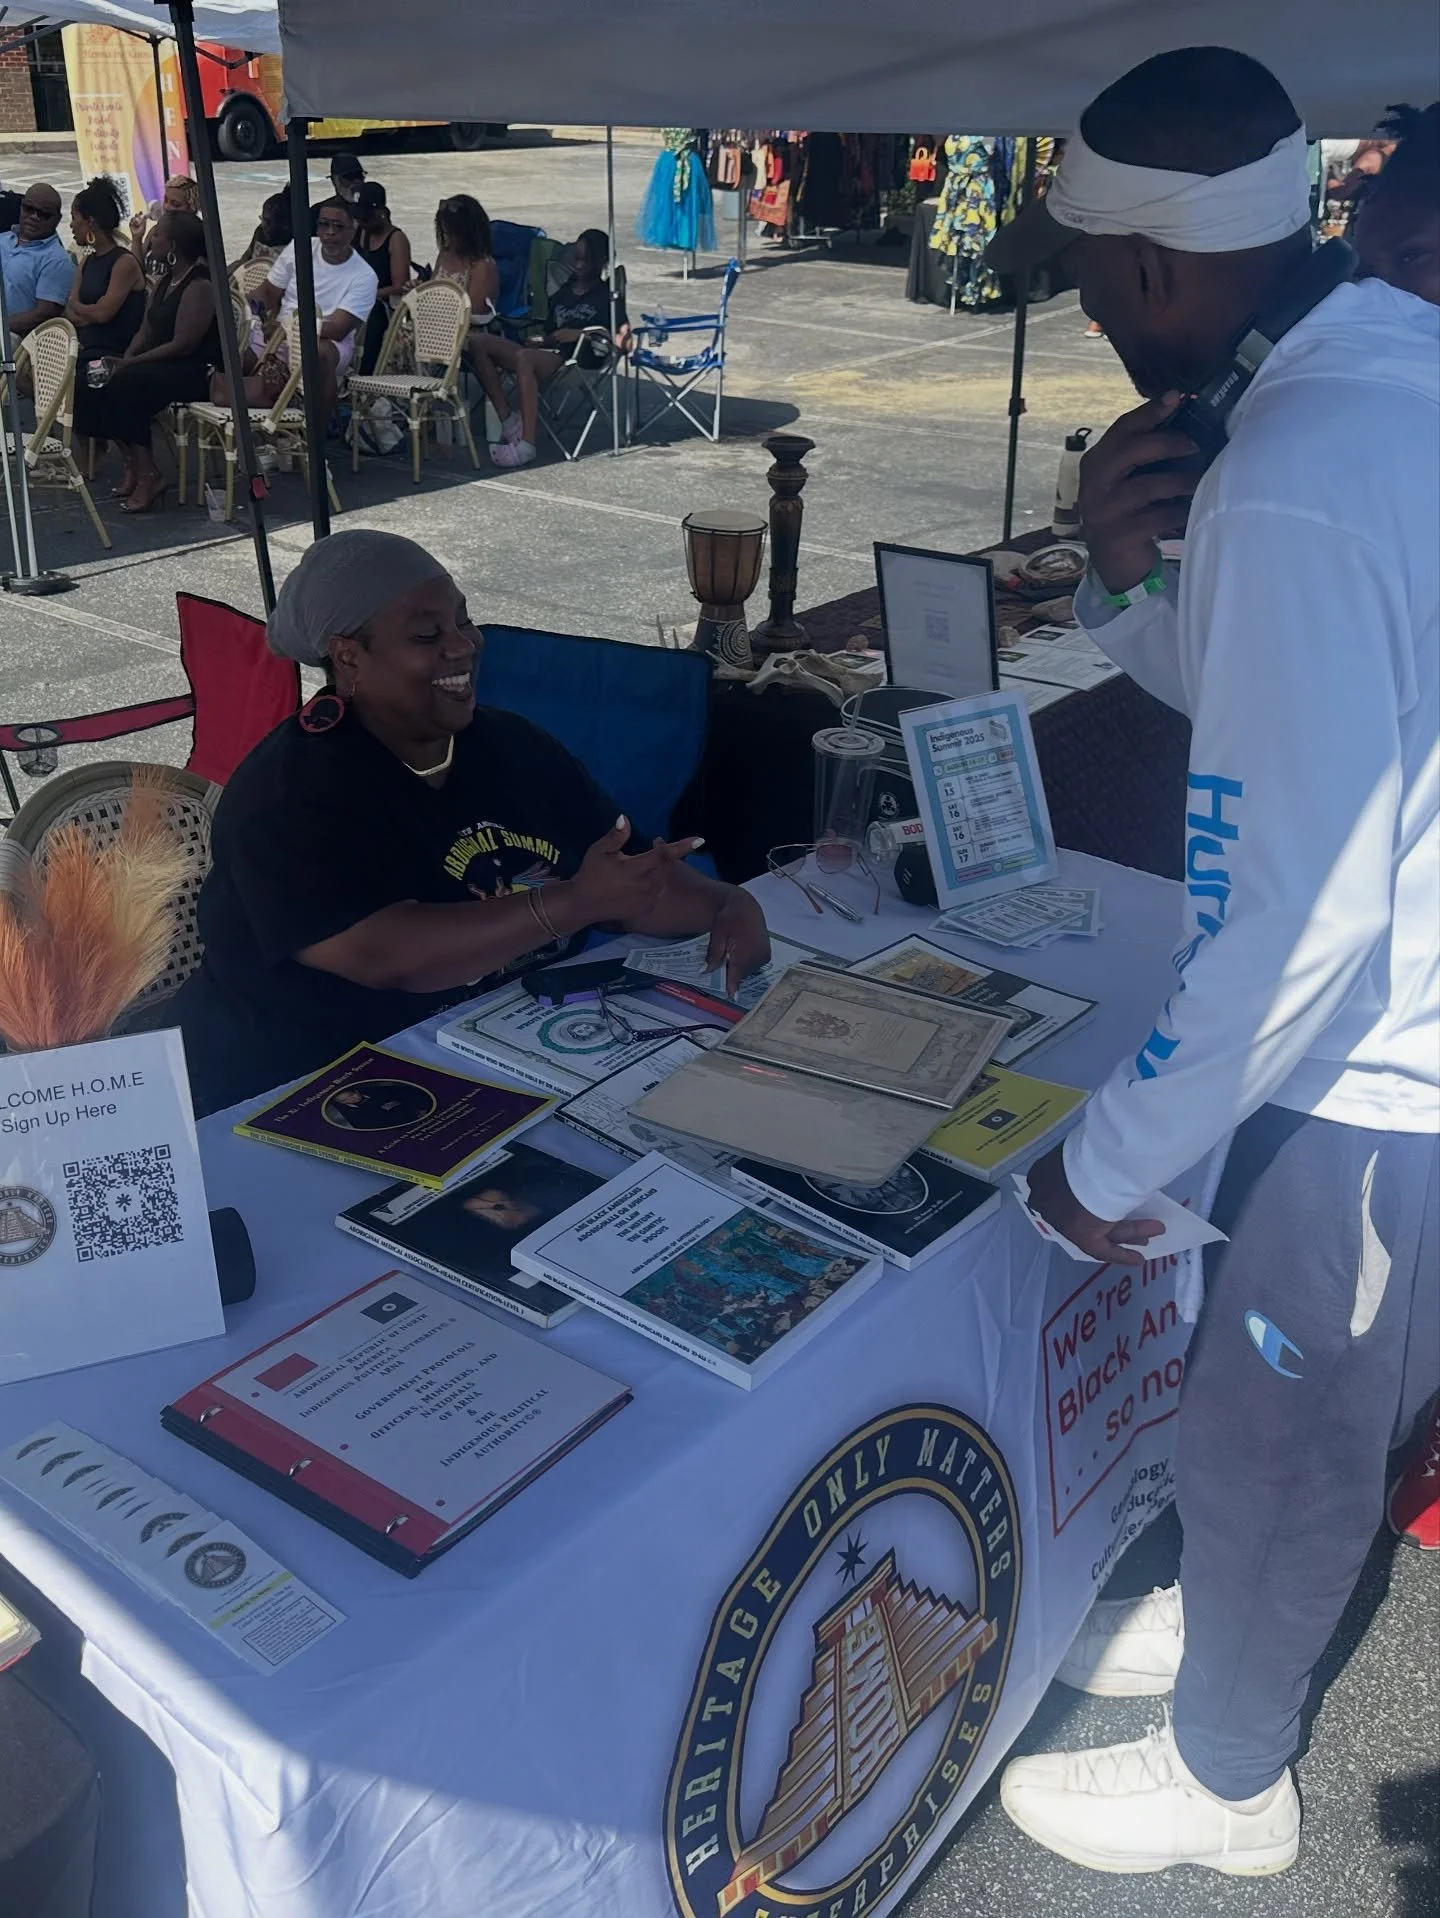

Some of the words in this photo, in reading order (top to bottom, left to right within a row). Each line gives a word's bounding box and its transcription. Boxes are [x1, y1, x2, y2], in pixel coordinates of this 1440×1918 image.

[930, 727, 974, 742] Indigenous
[932, 739, 962, 753] Summit
[964, 733, 985, 746] 2025
[944, 787, 955, 797] 15
[949, 809, 960, 819] 16
[500, 829, 561, 865] SUMMIT
[953, 831, 965, 841] 16
[959, 854, 969, 864] 17
[71, 1072, 144, 1096] H.O.M.E
[2, 1117, 40, 1133] Sign
[46, 1110, 70, 1126] Up
[76, 1103, 117, 1120] Here
[586, 1210, 609, 1225] BLACK
[616, 1228, 631, 1237] THE
[629, 1211, 656, 1229] HISTORY
[628, 1211, 640, 1220] LAW
[640, 1217, 666, 1234] GENETIC
[642, 1226, 669, 1243] PROOFS
[1053, 1273, 1133, 1370] We're
[293, 1361, 347, 1399] ABORIGINAL
[347, 1339, 386, 1364] REPUBLIC
[400, 1313, 428, 1332] NORTH
[353, 1347, 393, 1372] AMERICA
[354, 1375, 423, 1421] GOVERNMENT
[421, 1341, 475, 1376] PROTOCOLS
[379, 1361, 405, 1377] ARNA
[299, 1381, 354, 1418] INDIGENOUS
[354, 1353, 397, 1382] POLITICAL
[370, 1404, 424, 1439] OFFICERS,
[421, 1367, 478, 1403] MINISTERS,
[479, 1352, 499, 1367] AND
[415, 1379, 436, 1395] FOR
[1057, 1335, 1132, 1435] Black
[420, 1382, 475, 1419] NATIONALS
[438, 1409, 453, 1421] OF
[454, 1391, 483, 1412] ARNA
[467, 1408, 478, 1416] &
[439, 1422, 501, 1467] INDIGENOUS
[500, 1388, 549, 1423] POLITICAL
[475, 1411, 497, 1426] THE
[1106, 1394, 1134, 1442] so
[683, 1568, 782, 1877] HERITAGE
[801, 1434, 892, 1540] ONLY
[917, 1427, 1012, 1580] MATTERS
